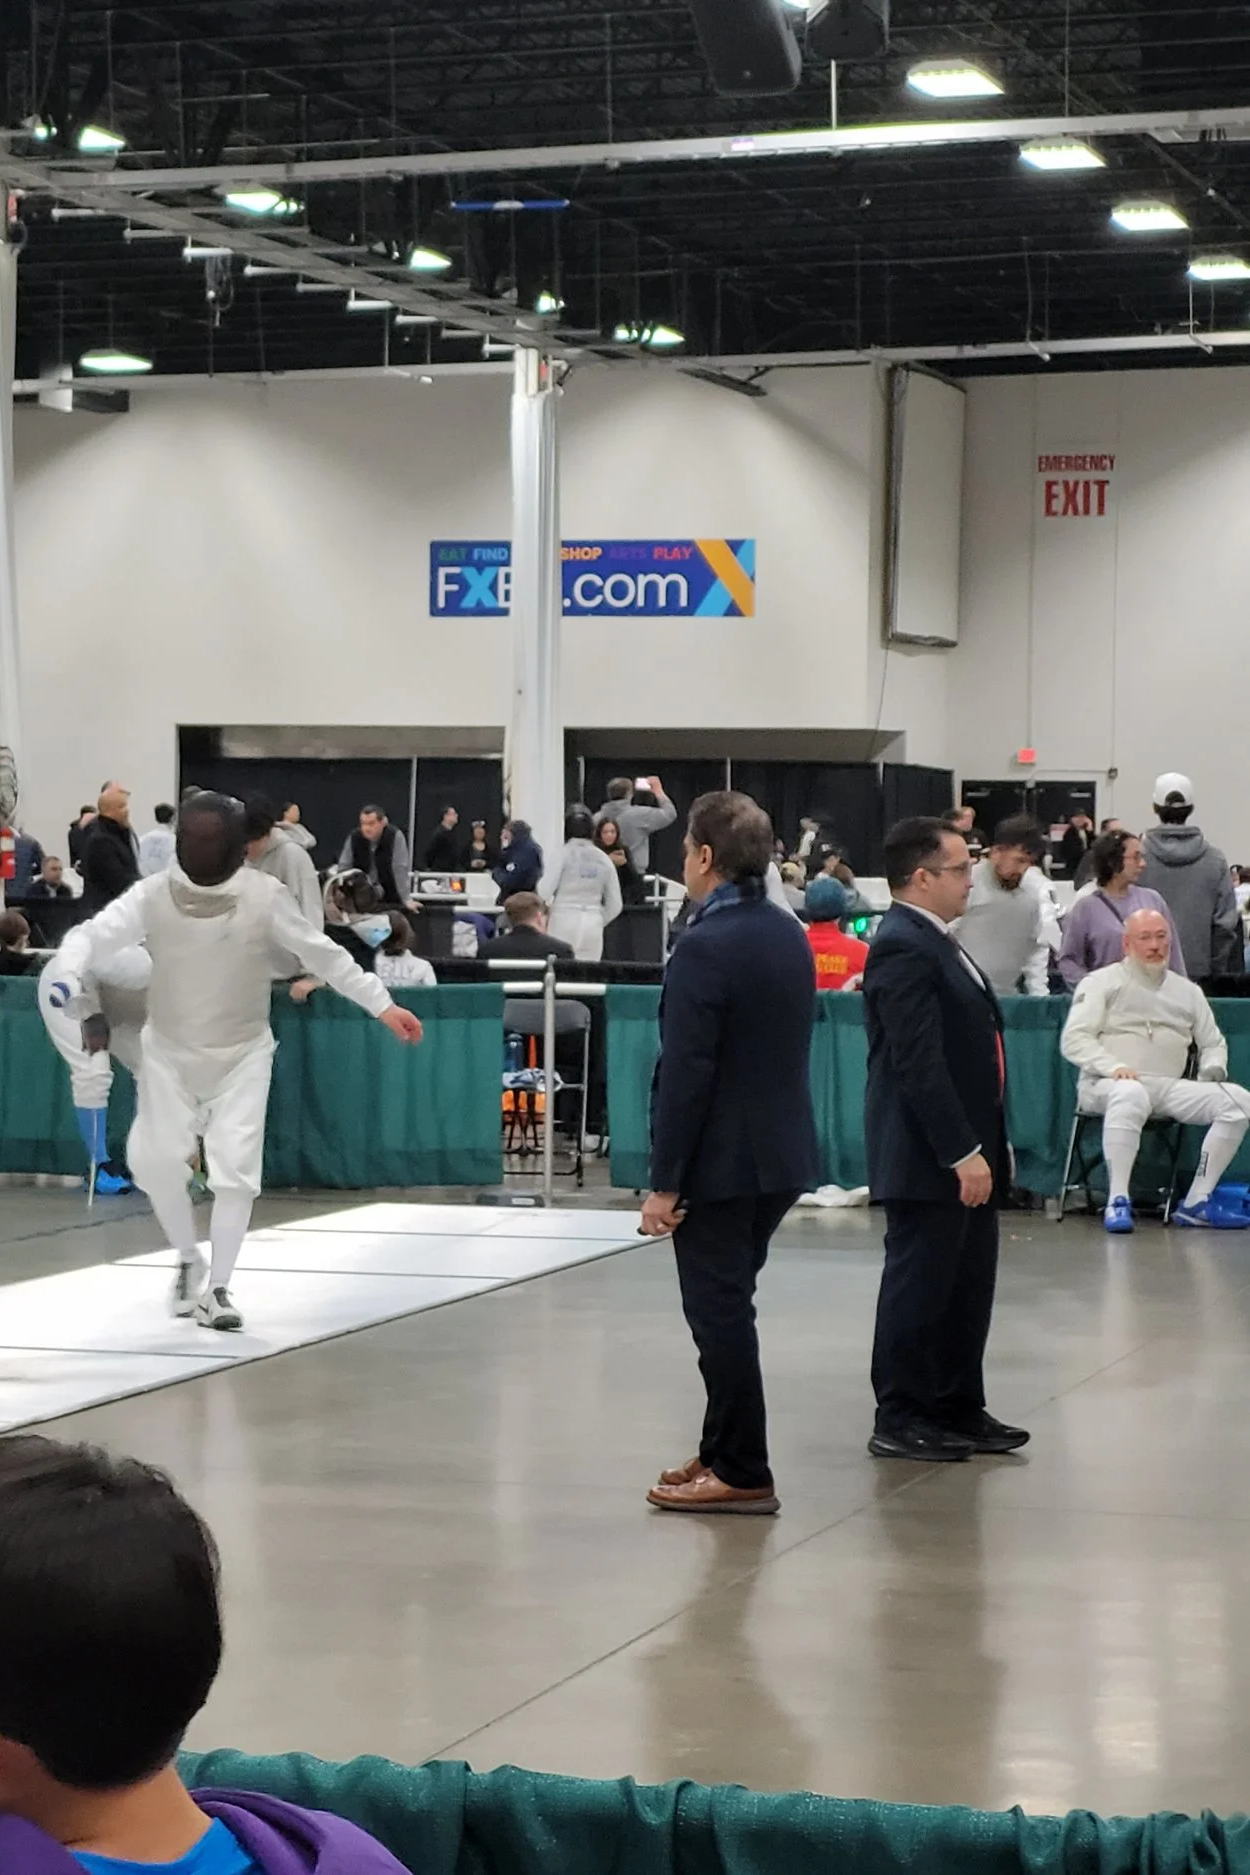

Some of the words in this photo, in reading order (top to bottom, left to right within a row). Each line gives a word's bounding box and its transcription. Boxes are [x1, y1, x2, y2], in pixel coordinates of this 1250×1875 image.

[1038, 454, 1116, 472] EMERGENCY
[1045, 480, 1110, 516] EXIT
[473, 547, 509, 561] FIND
[559, 546, 602, 561] SHOP
[653, 546, 692, 560] PLAY
